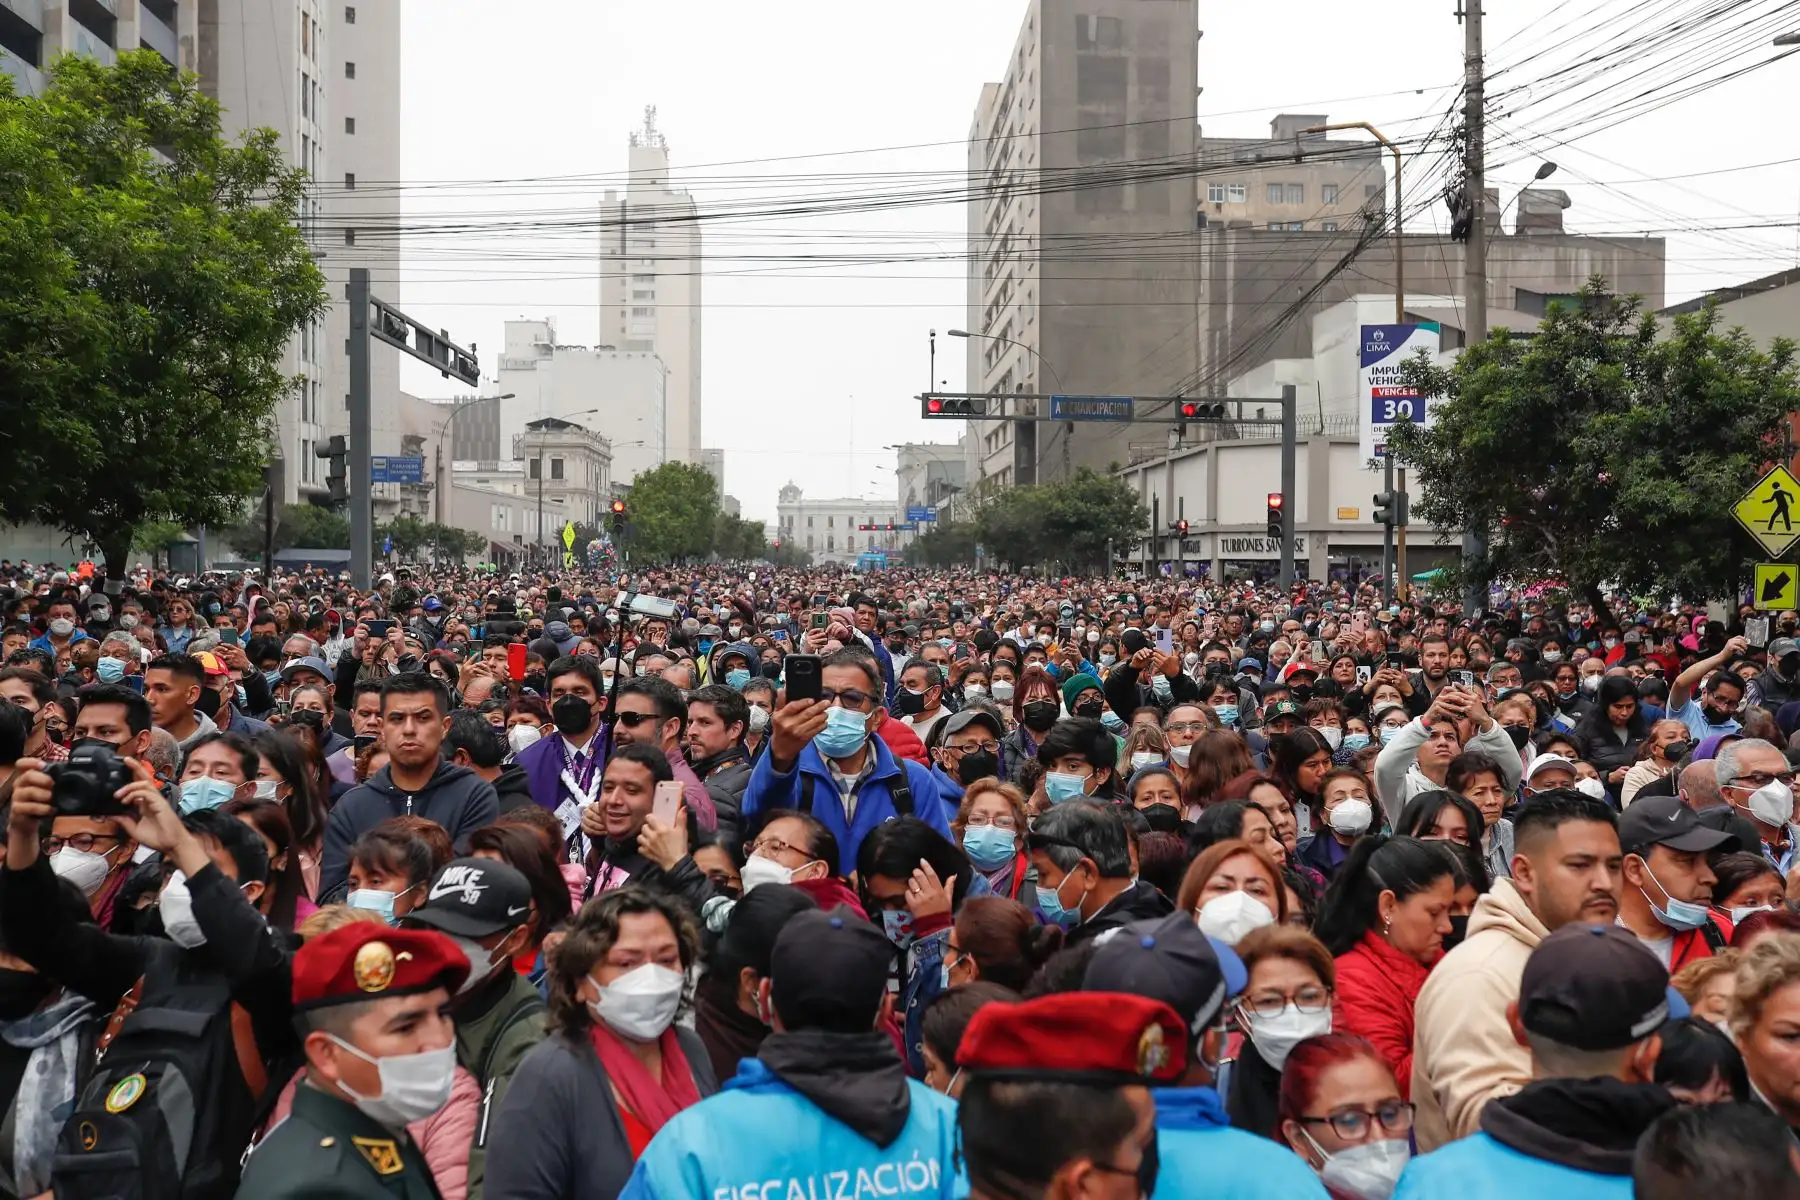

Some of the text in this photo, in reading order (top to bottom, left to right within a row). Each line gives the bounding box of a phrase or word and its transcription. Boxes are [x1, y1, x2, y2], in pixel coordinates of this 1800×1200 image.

[1366, 344, 1391, 352] LIMA
[1378, 387, 1407, 396] VENCE
[1383, 400, 1414, 420] 30
[1221, 537, 1264, 553] TURRONES
[1266, 536, 1282, 553] SAN
[441, 866, 485, 889] NIKE
[460, 888, 482, 905] SB
